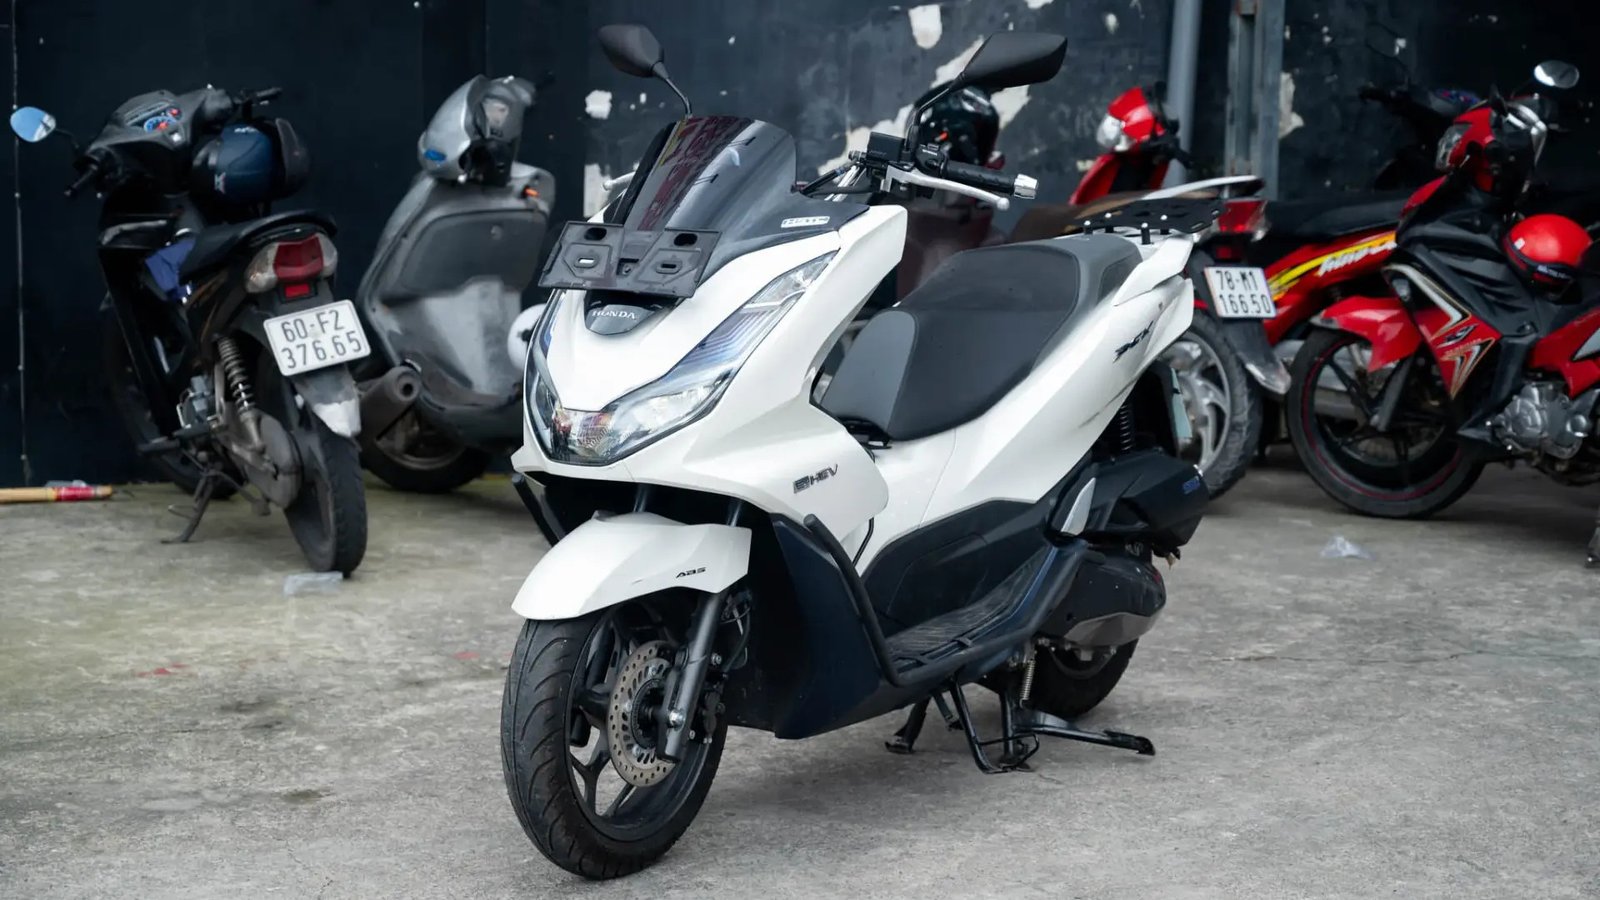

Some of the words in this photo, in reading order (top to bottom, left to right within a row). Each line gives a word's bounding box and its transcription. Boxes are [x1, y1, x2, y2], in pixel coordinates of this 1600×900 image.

[1215, 270, 1258, 290] 78-M1
[1219, 293, 1271, 314] 166.50
[592, 310, 635, 319] HONDA
[281, 310, 345, 342] 60-F2
[281, 331, 362, 369] 376.65
[676, 566, 706, 579] ABS
